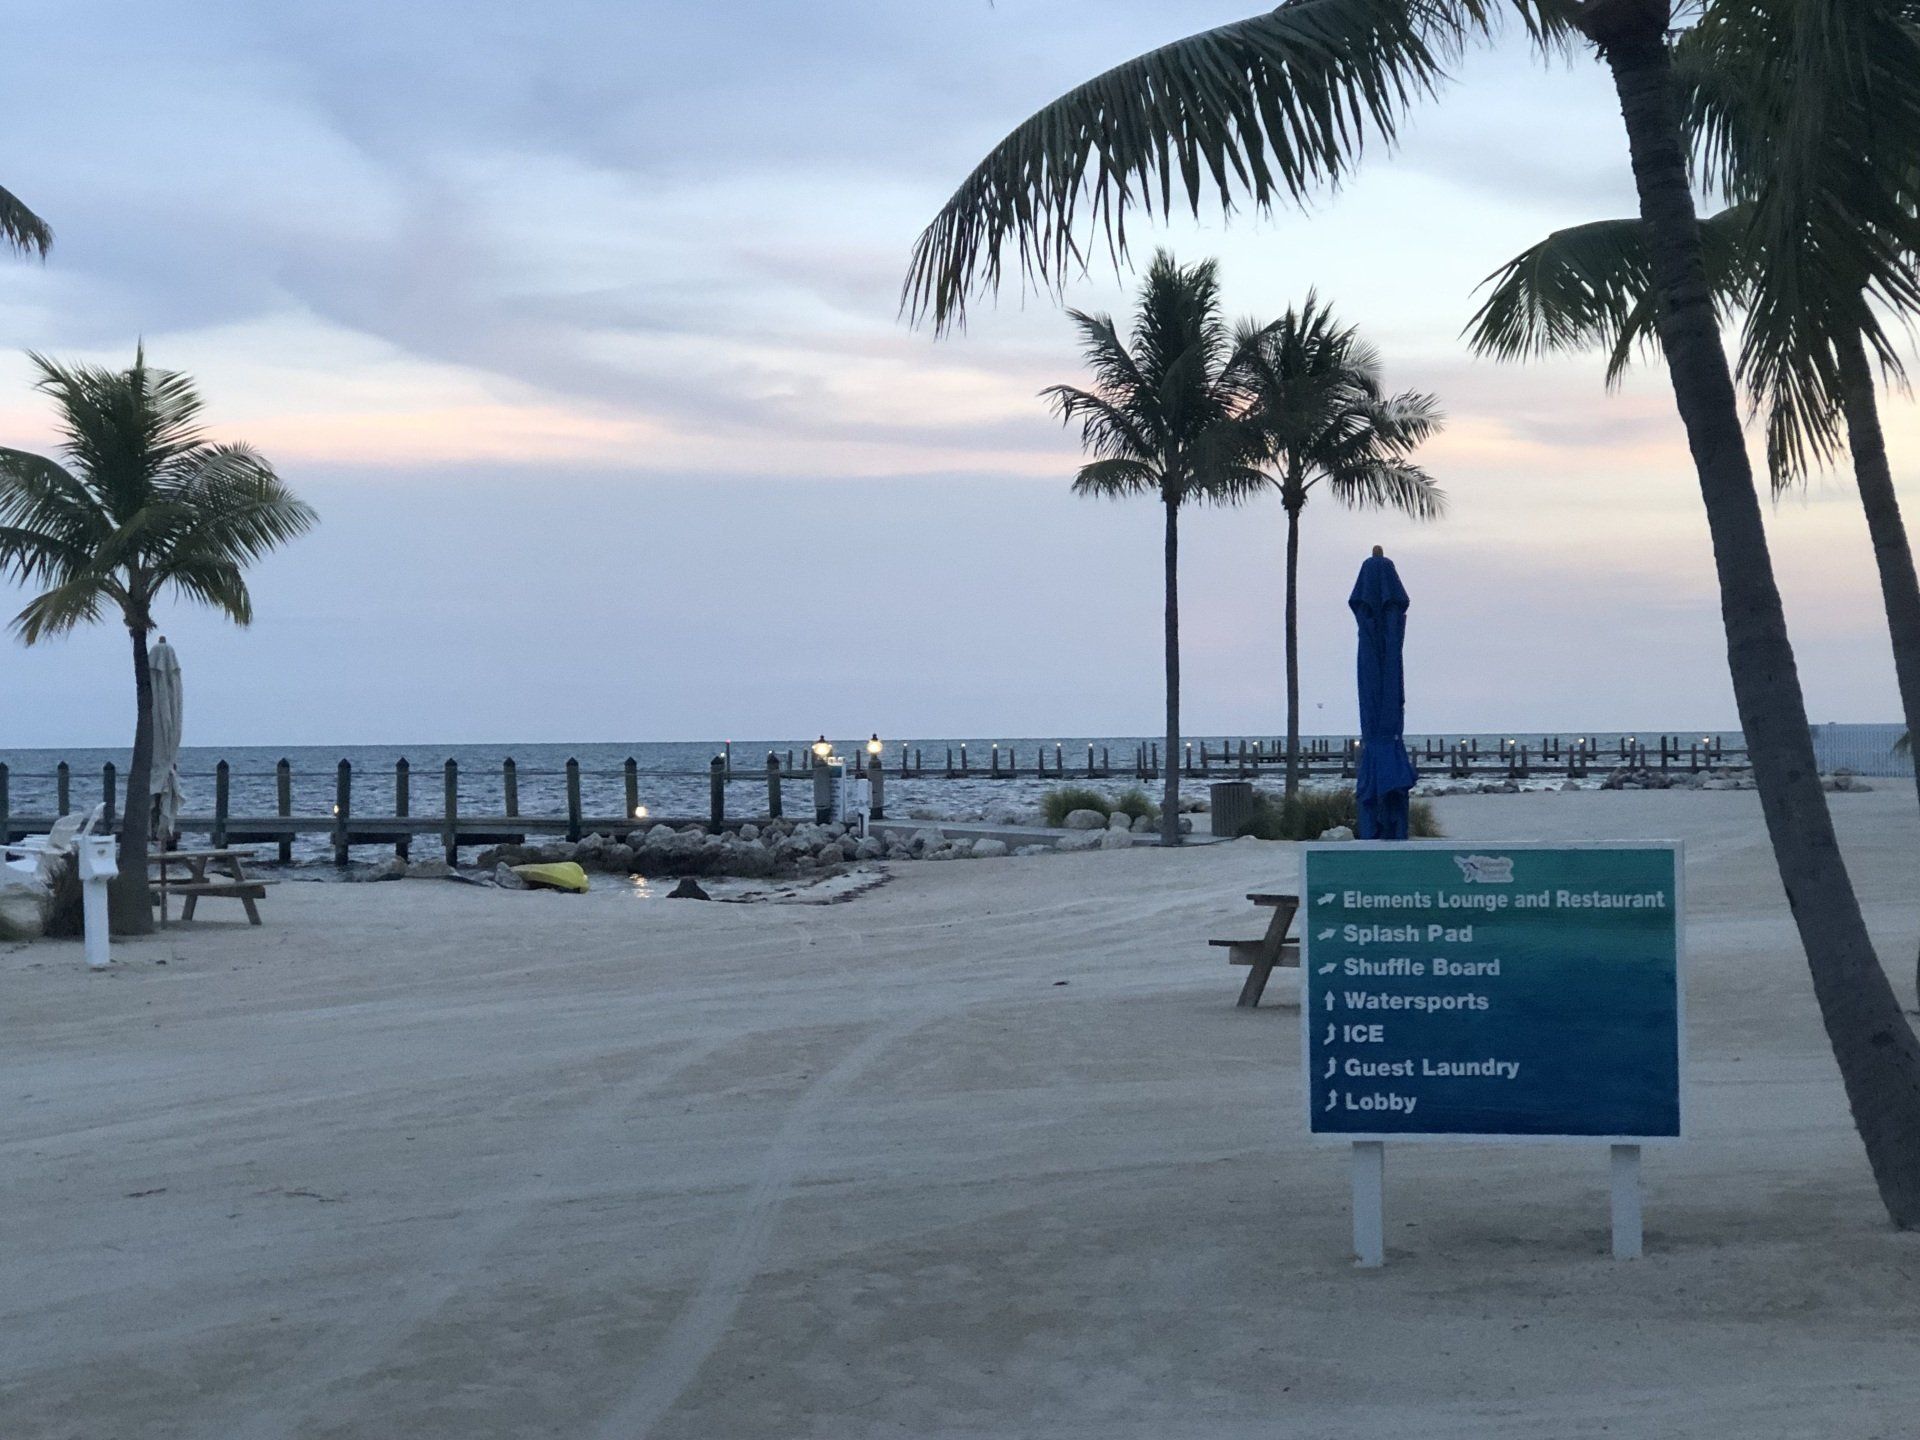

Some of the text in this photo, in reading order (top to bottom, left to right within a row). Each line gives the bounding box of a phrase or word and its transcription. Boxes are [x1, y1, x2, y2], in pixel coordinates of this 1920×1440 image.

[1343, 889, 1664, 911] Elements Lounge and Restaurant
[1343, 924, 1472, 945] Splash Pad
[1344, 957, 1500, 976] Shuffle Board
[1343, 991, 1489, 1012] Watersports
[1344, 1024, 1384, 1043] ICE
[1344, 1058, 1520, 1079] Guest Laundry
[1345, 1092, 1417, 1114] Lobby
